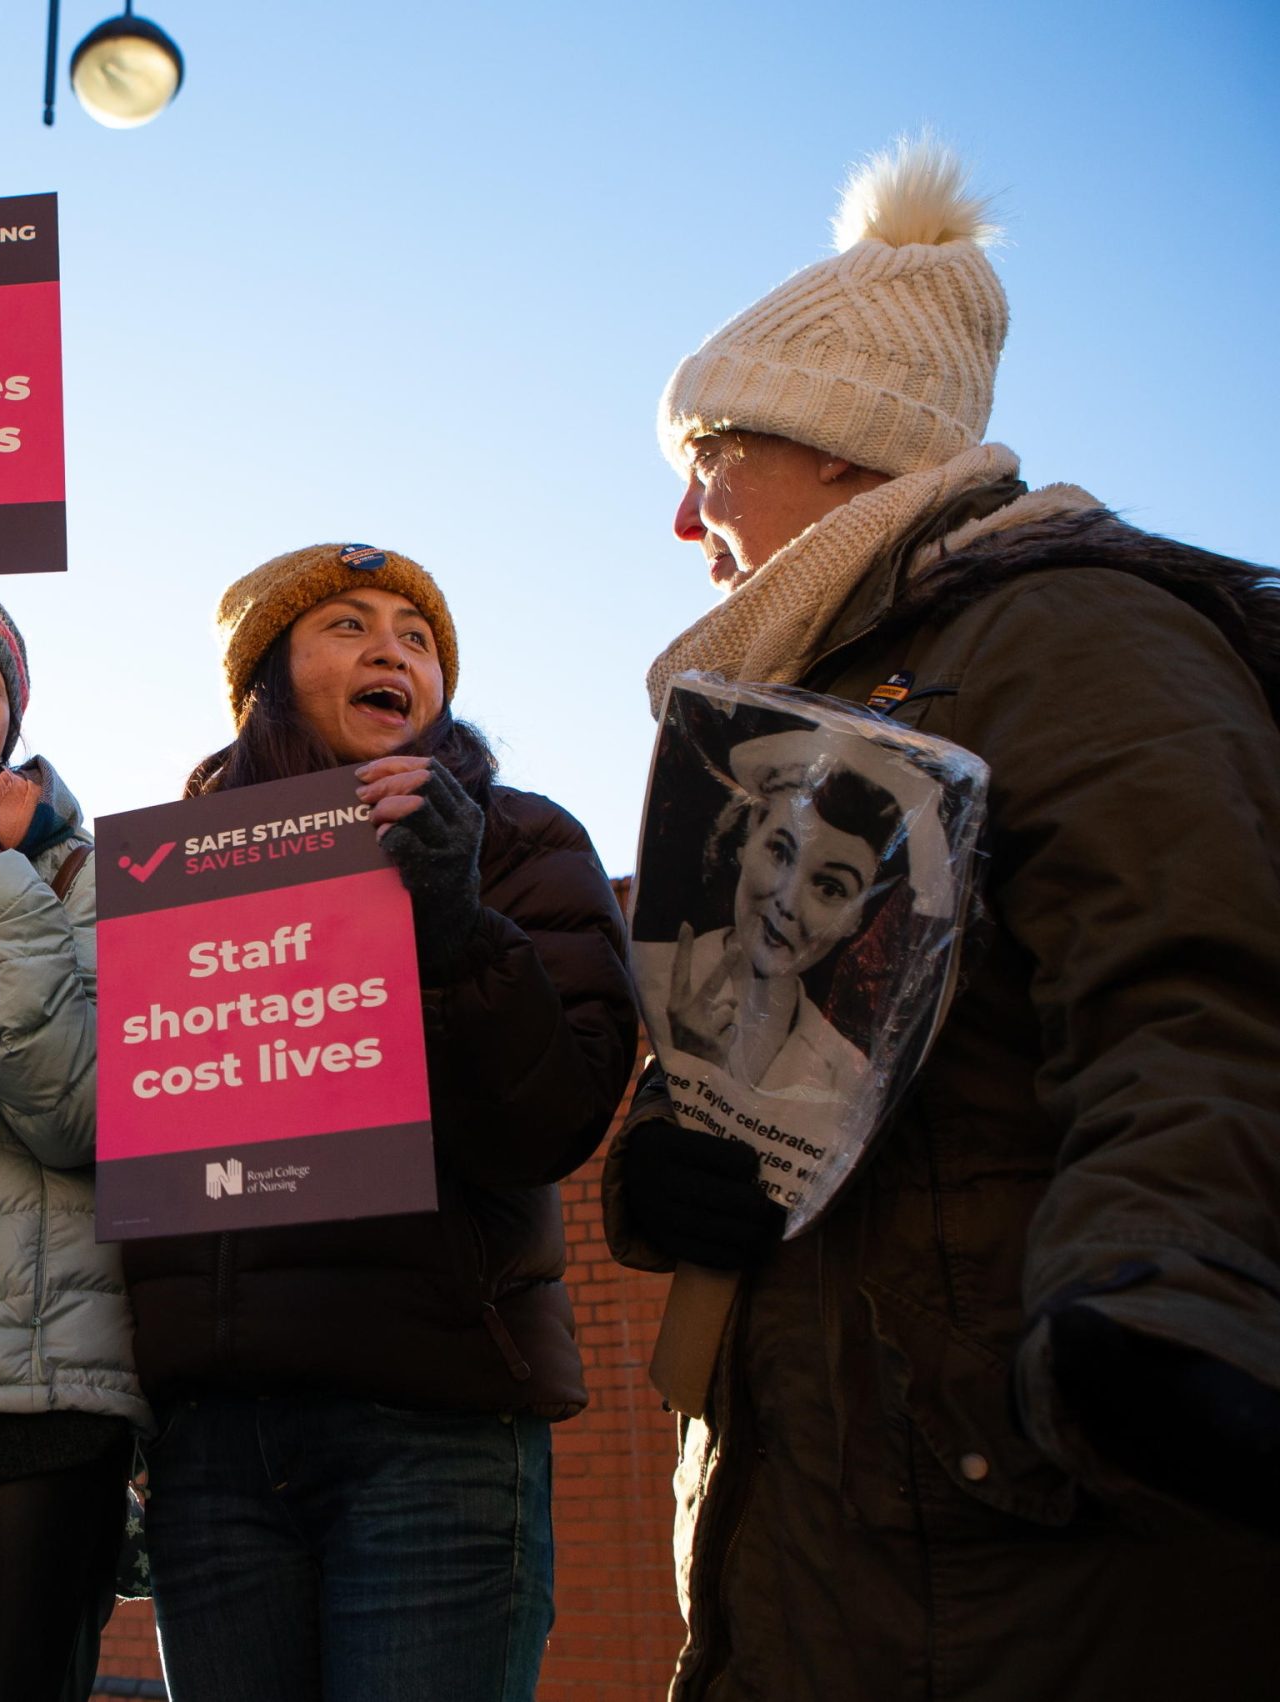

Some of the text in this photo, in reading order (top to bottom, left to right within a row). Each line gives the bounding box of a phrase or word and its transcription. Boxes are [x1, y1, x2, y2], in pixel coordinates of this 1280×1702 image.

[184, 805, 374, 855] SAFE STAFFING
[185, 831, 336, 875] SAVES LIVES
[188, 922, 312, 978] Staff
[123, 976, 388, 1044] shortages
[132, 1037, 382, 1099] cost lives
[665, 1072, 691, 1090] rse
[696, 1080, 735, 1117] Taylor
[736, 1113, 826, 1160] celebrated
[673, 1101, 726, 1137] existent
[247, 1165, 310, 1181] Royal College
[247, 1179, 297, 1193] of Nursing
